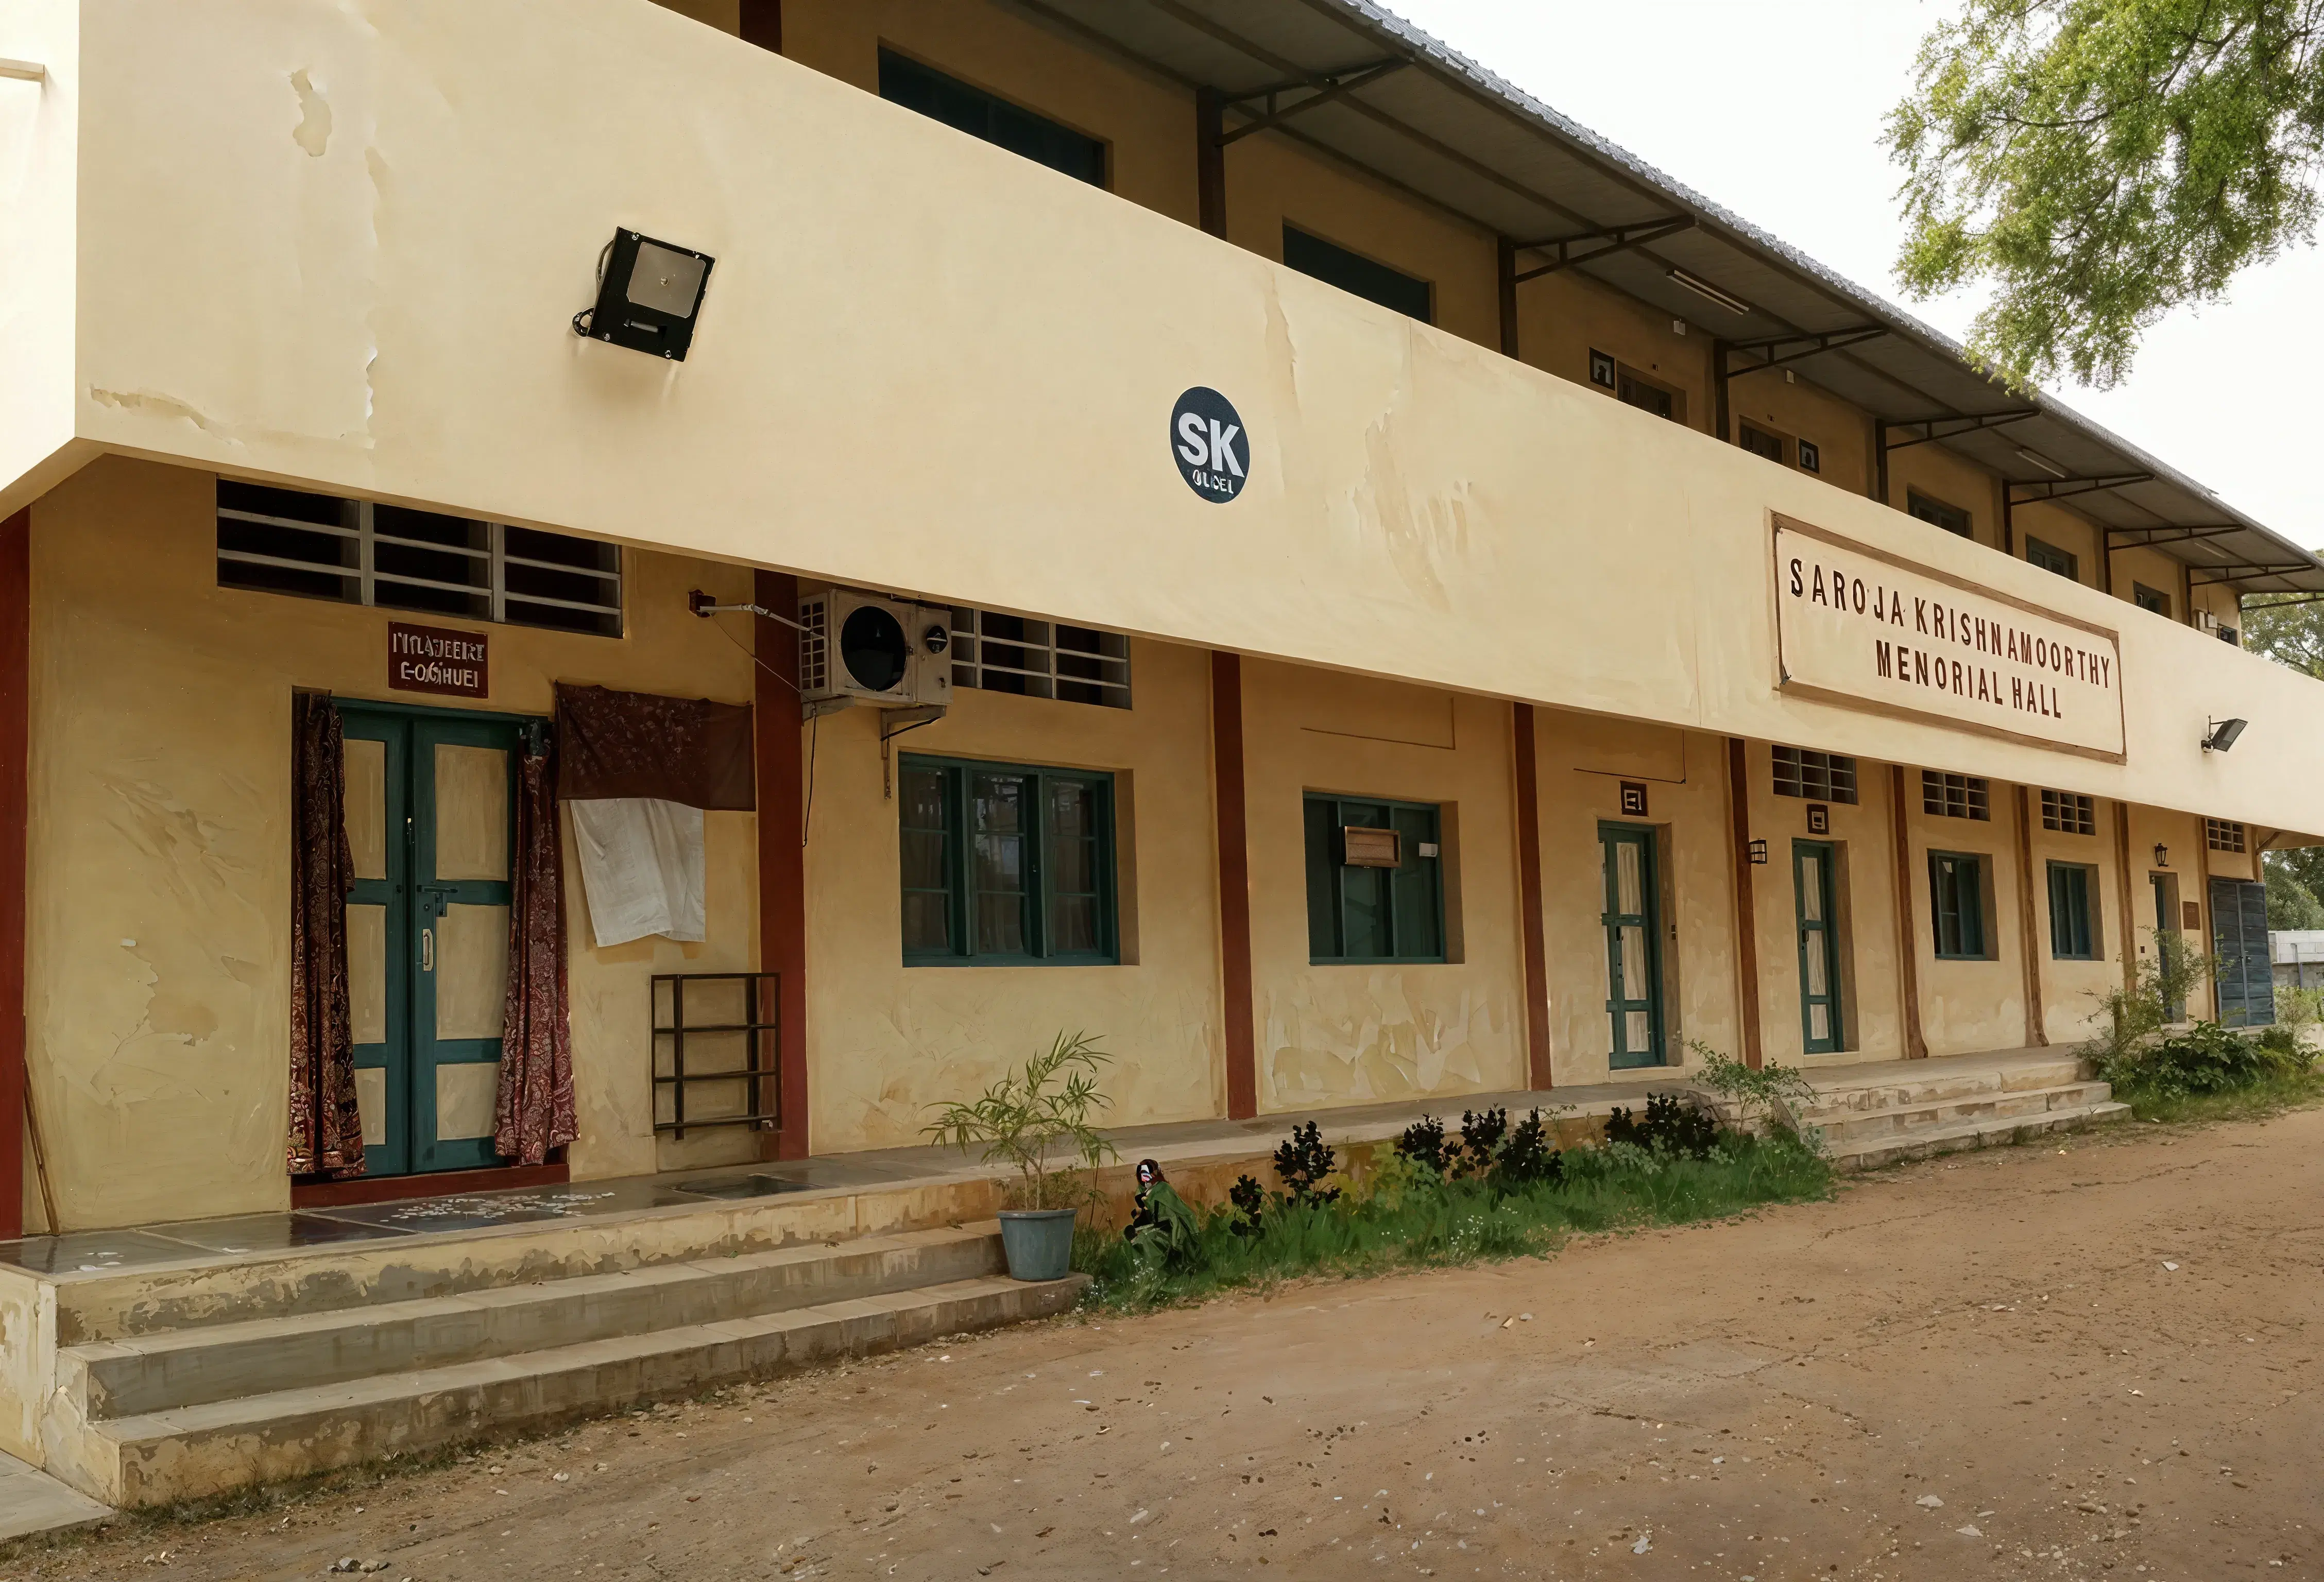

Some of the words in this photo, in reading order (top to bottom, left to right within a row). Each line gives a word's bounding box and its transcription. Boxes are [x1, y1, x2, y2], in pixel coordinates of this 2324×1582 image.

[1177, 412, 1245, 478] SK
[1790, 558, 1904, 627] SAROJA
[1915, 597, 2110, 689] KRISHNAMOORTHY
[2011, 676, 2061, 719] HALL
